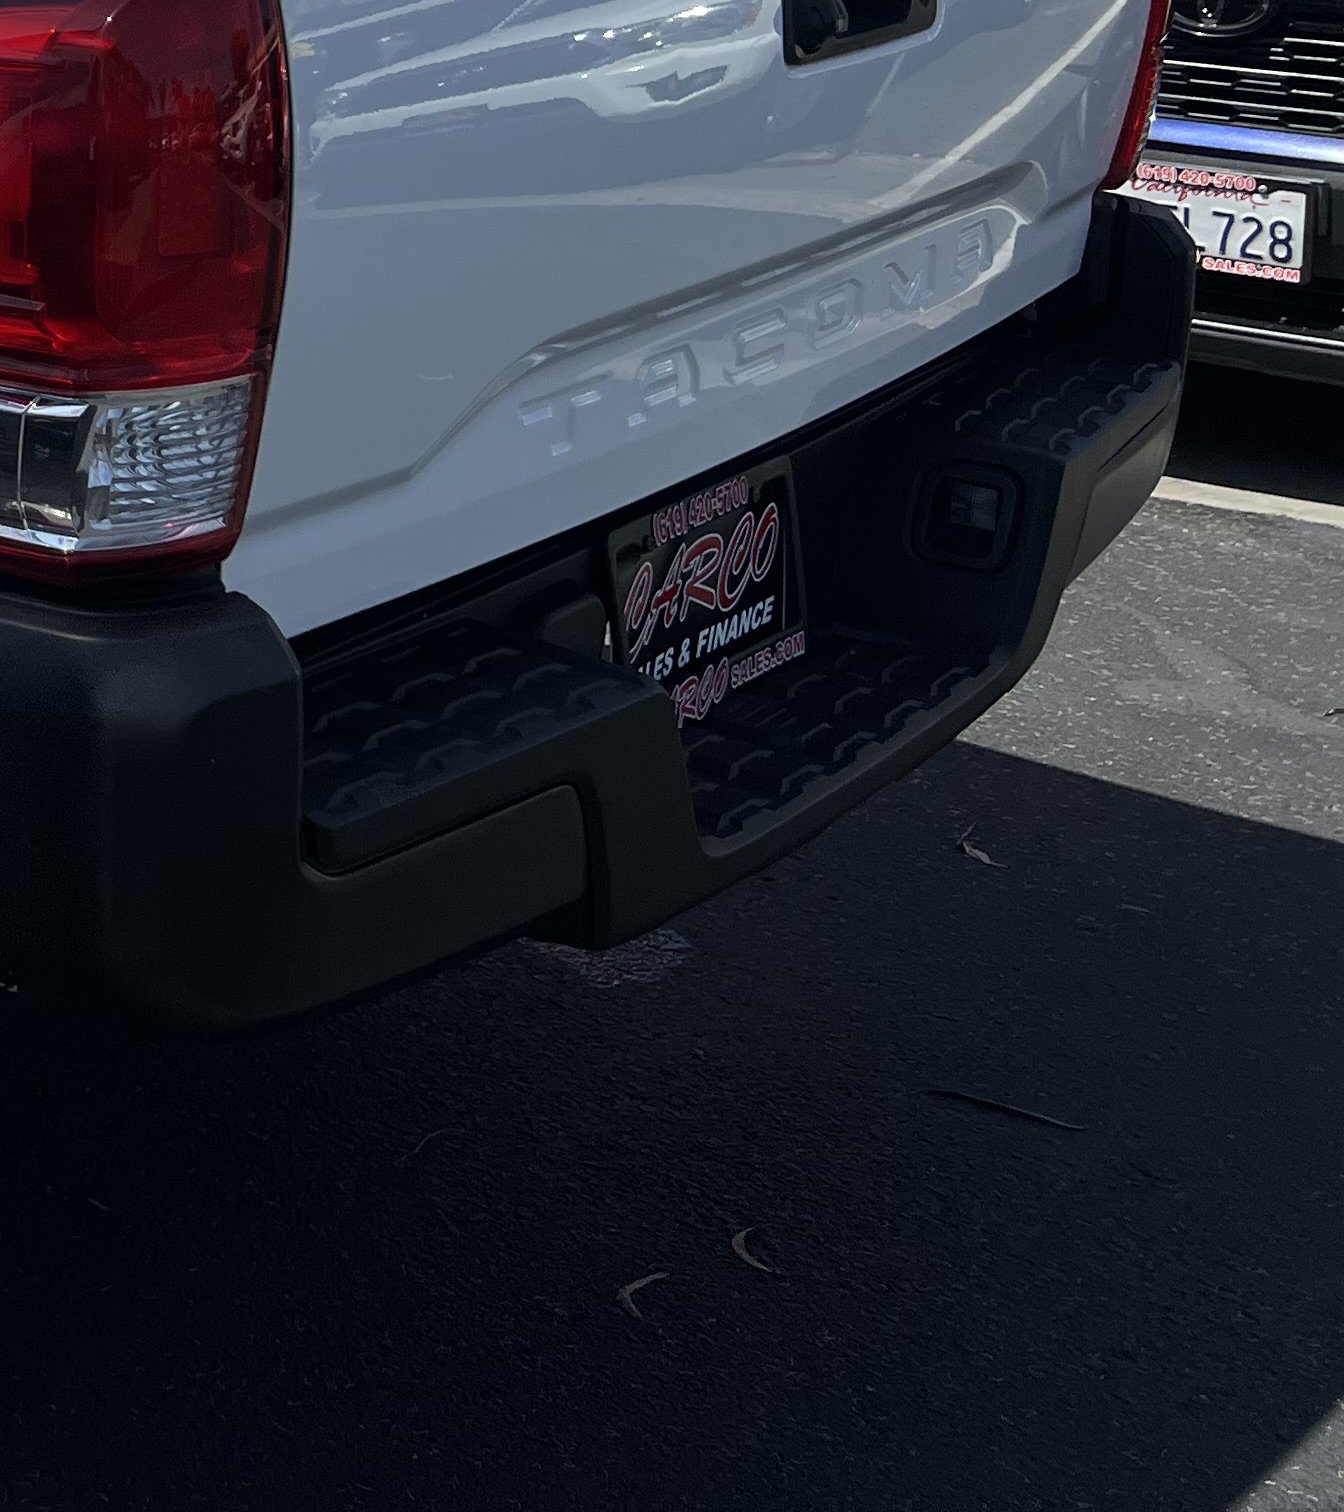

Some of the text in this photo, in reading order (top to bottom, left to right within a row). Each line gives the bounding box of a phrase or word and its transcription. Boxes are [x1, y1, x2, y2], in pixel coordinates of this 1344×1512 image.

[1136, 163, 1257, 192] (619) 420-5700
[1202, 257, 1302, 284] SALES.COM
[517, 218, 994, 456] TACOMA
[652, 476, 750, 547] (619) 420-5700
[624, 502, 779, 664] CARCO
[678, 638, 691, 668] &
[696, 594, 776, 659] FINANCE
[671, 631, 806, 728] RCO SALES.COM
